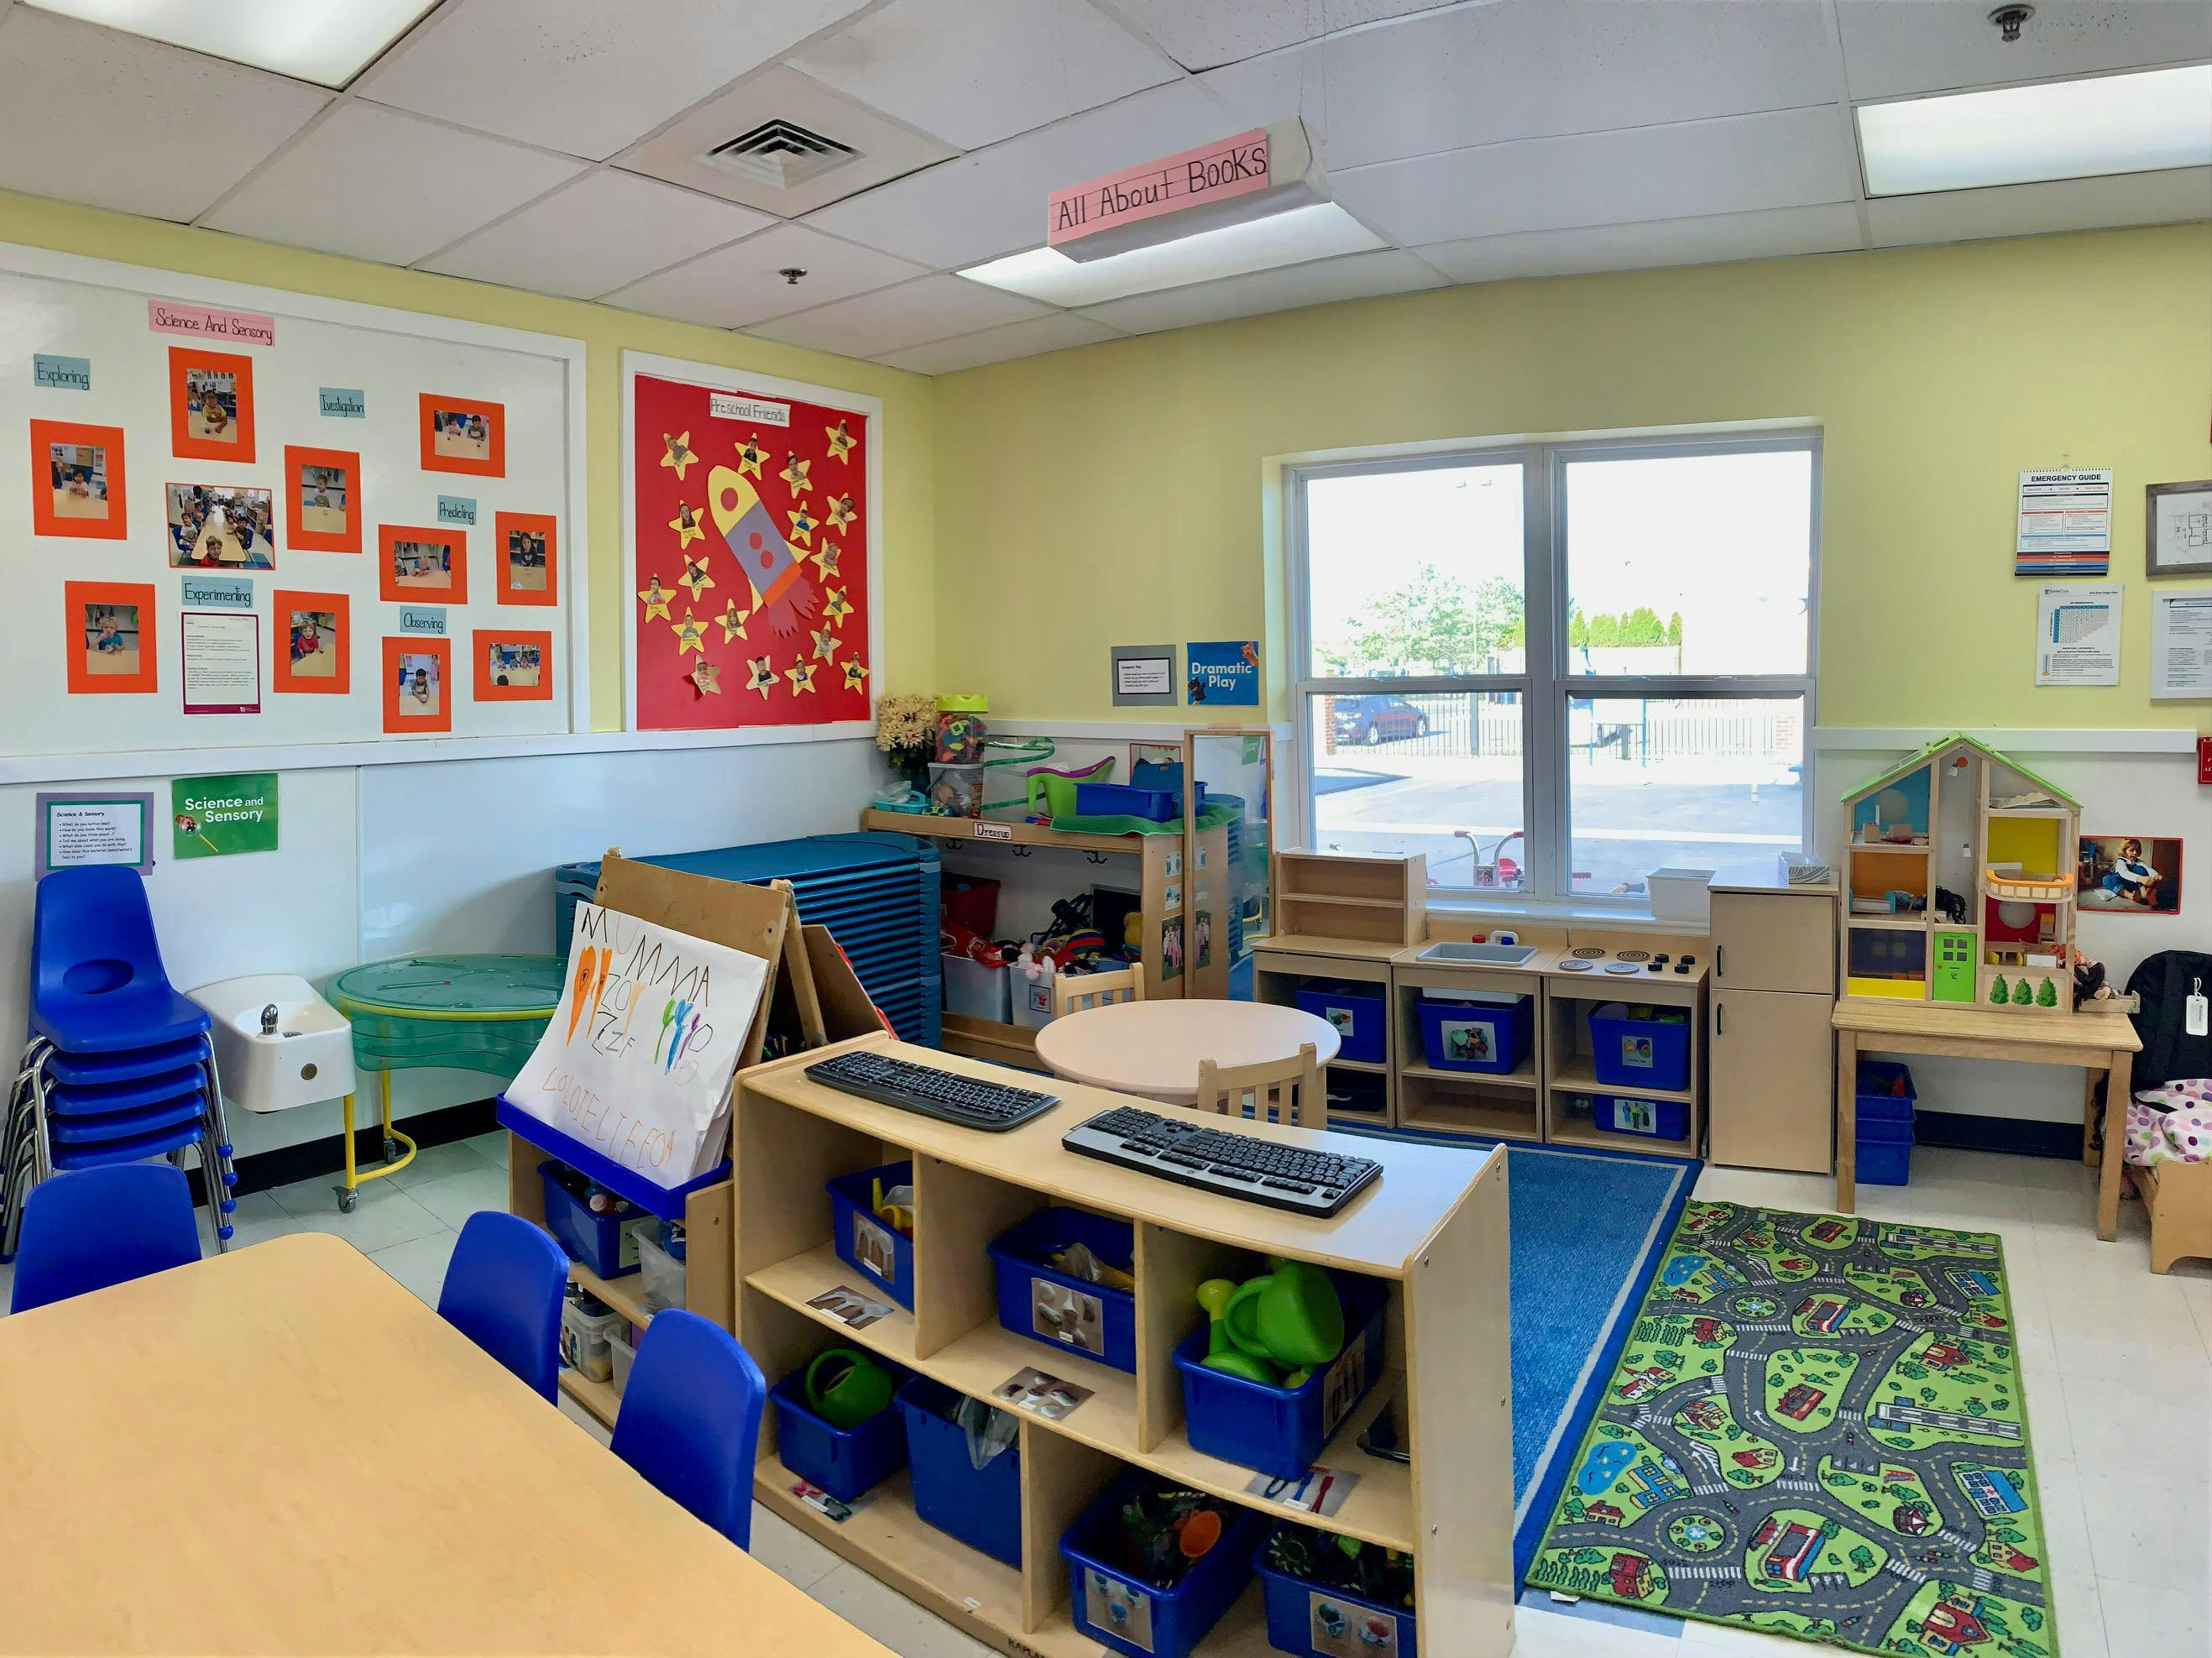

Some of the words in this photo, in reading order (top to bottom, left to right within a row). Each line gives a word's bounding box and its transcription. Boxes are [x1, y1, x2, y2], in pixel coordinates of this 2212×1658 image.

[1059, 195, 1086, 230] All
[1101, 170, 1173, 217] About
[155, 307, 200, 330] Science
[205, 315, 227, 333] And
[232, 318, 273, 346] Sensory
[37, 362, 89, 390] Exploring
[753, 404, 787, 422] Friends
[439, 501, 474, 525] Predicting
[185, 583, 252, 607] Experimenting
[404, 612, 443, 634] Observing
[1191, 662, 1252, 675] Dramatic
[1208, 675, 1237, 691] Play
[185, 796, 243, 811] Science
[244, 796, 264, 807] and
[205, 809, 264, 824] Sensory
